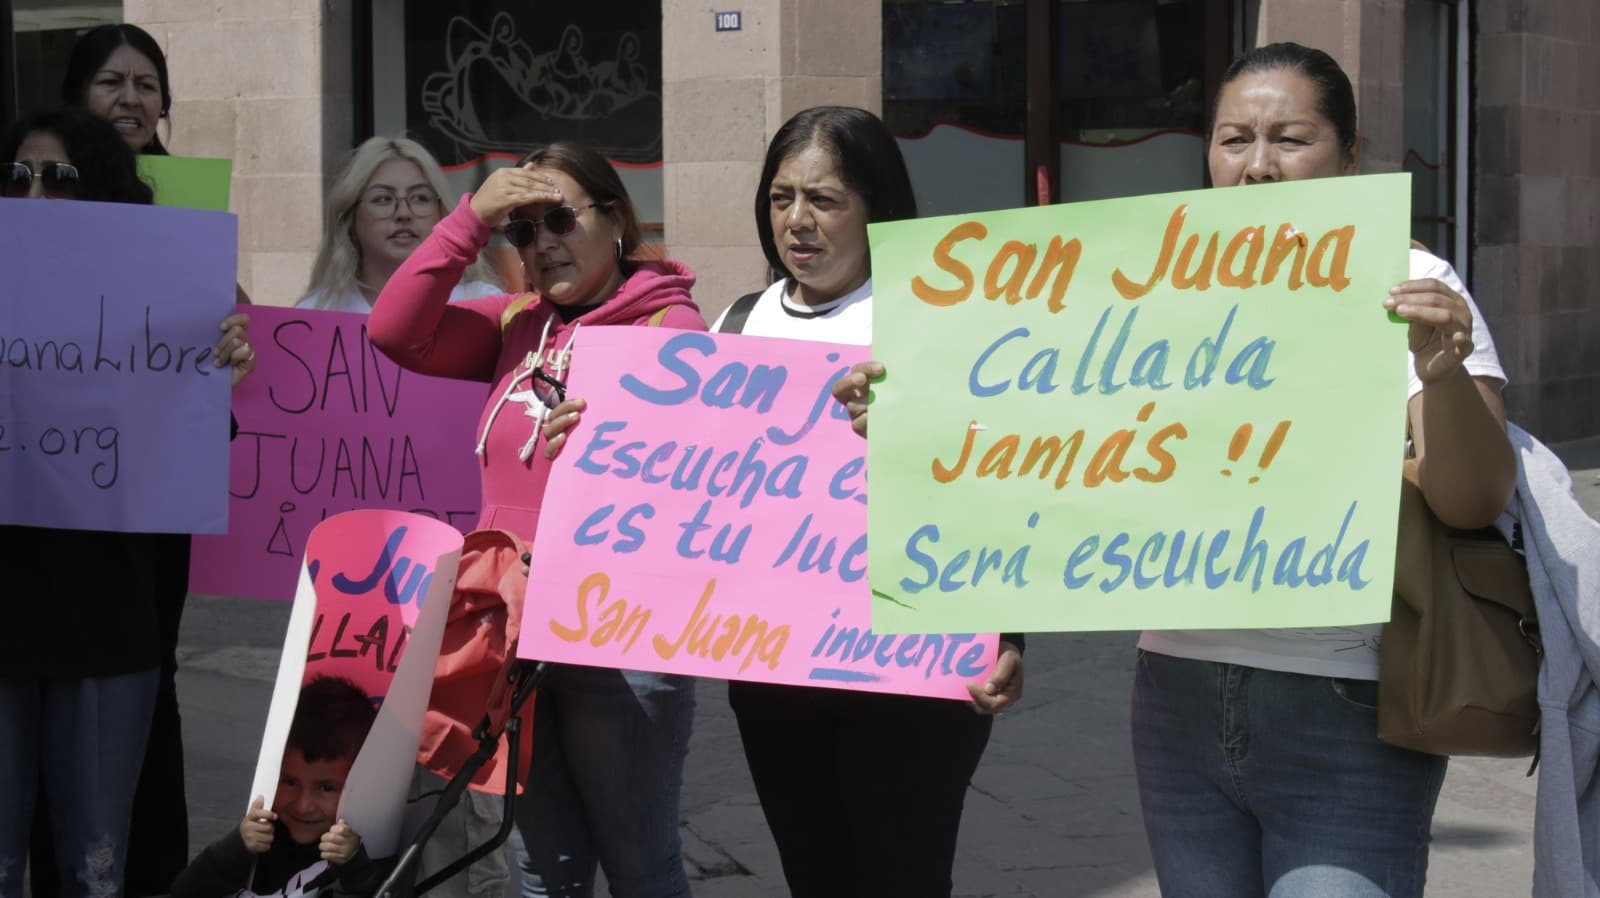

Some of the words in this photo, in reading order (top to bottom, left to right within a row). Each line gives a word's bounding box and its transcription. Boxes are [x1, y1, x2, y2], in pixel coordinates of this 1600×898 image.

[718, 13, 738, 29] 100
[911, 221, 1082, 313] San
[1111, 203, 1355, 300] Juana
[269, 319, 402, 418] SAN
[619, 332, 788, 414] San
[968, 304, 1277, 397] Callada
[229, 431, 425, 502] JUANA
[574, 421, 809, 508] Escucha
[573, 502, 656, 554] es
[676, 500, 753, 565] tu
[1063, 500, 1373, 594] escuchada
[549, 572, 652, 655] San
[652, 577, 792, 674] Juana
